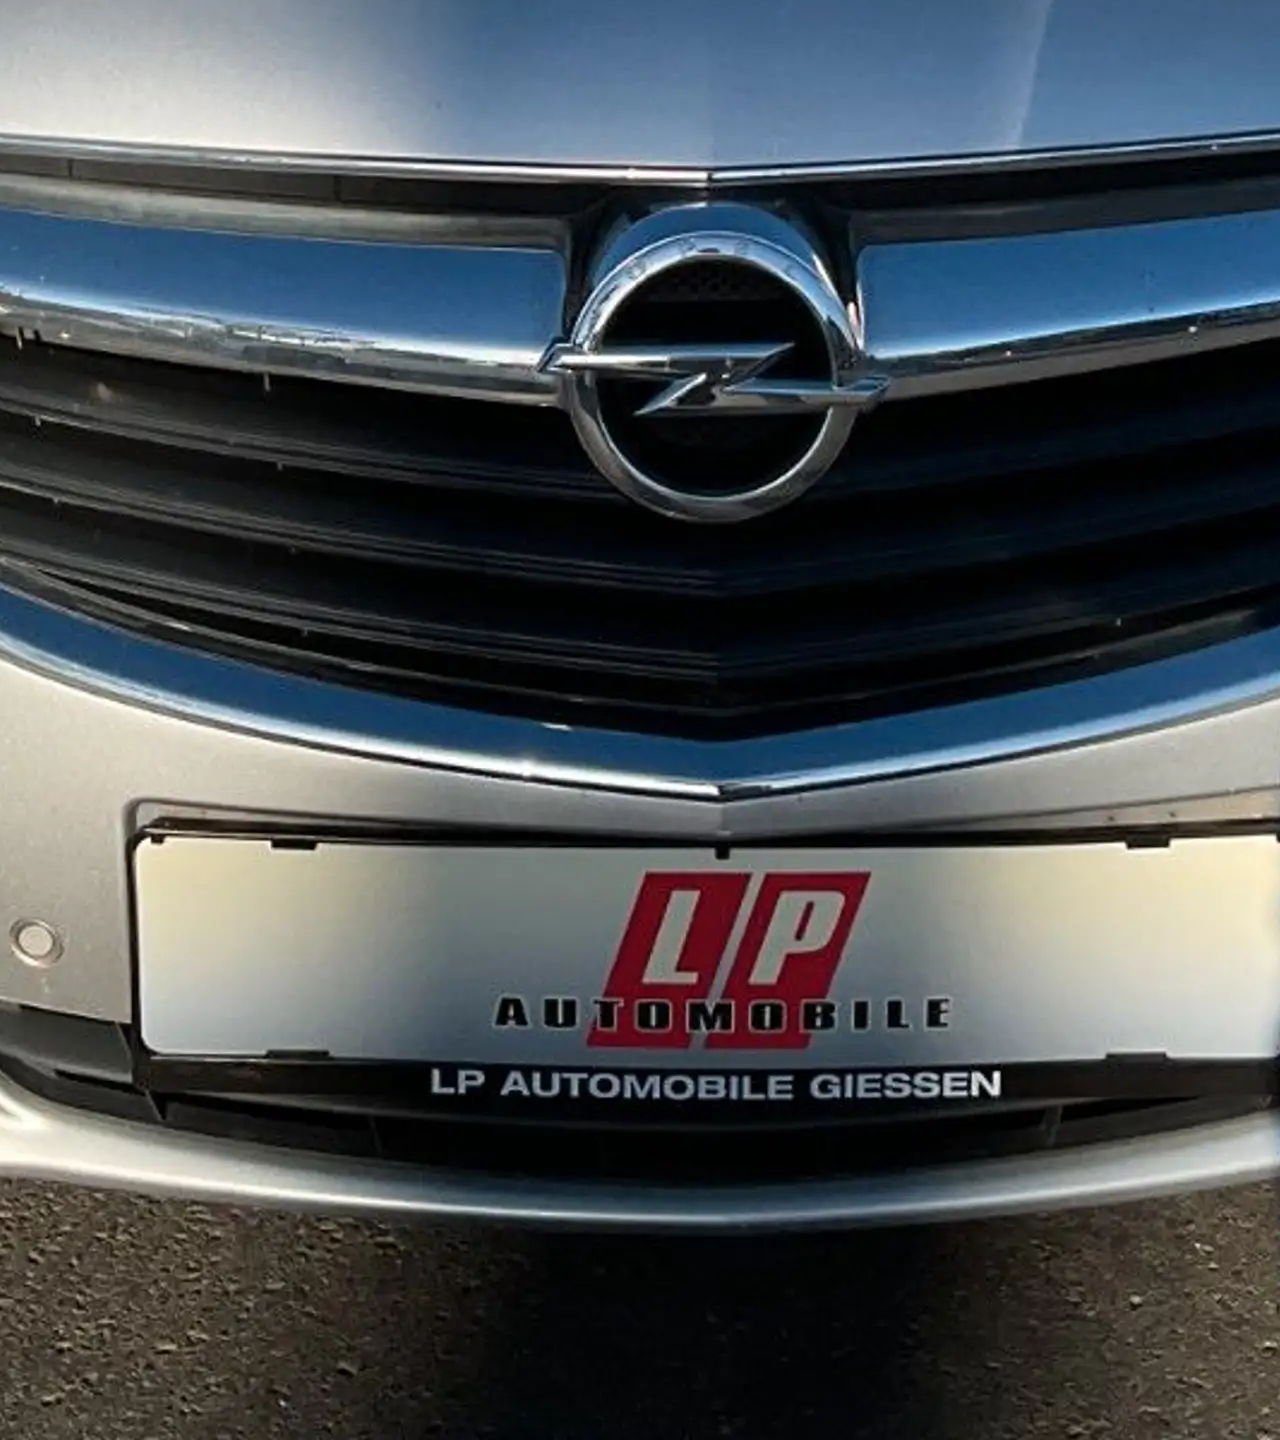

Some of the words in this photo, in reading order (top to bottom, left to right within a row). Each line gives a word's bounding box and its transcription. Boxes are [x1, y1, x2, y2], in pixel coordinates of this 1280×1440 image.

[642, 889, 846, 985] LP
[494, 996, 952, 1033] AUTOMOBILE
[431, 1069, 485, 1095] LP
[500, 1071, 794, 1101] AUTOMOBILE
[810, 1070, 1003, 1101] GIESSEN
